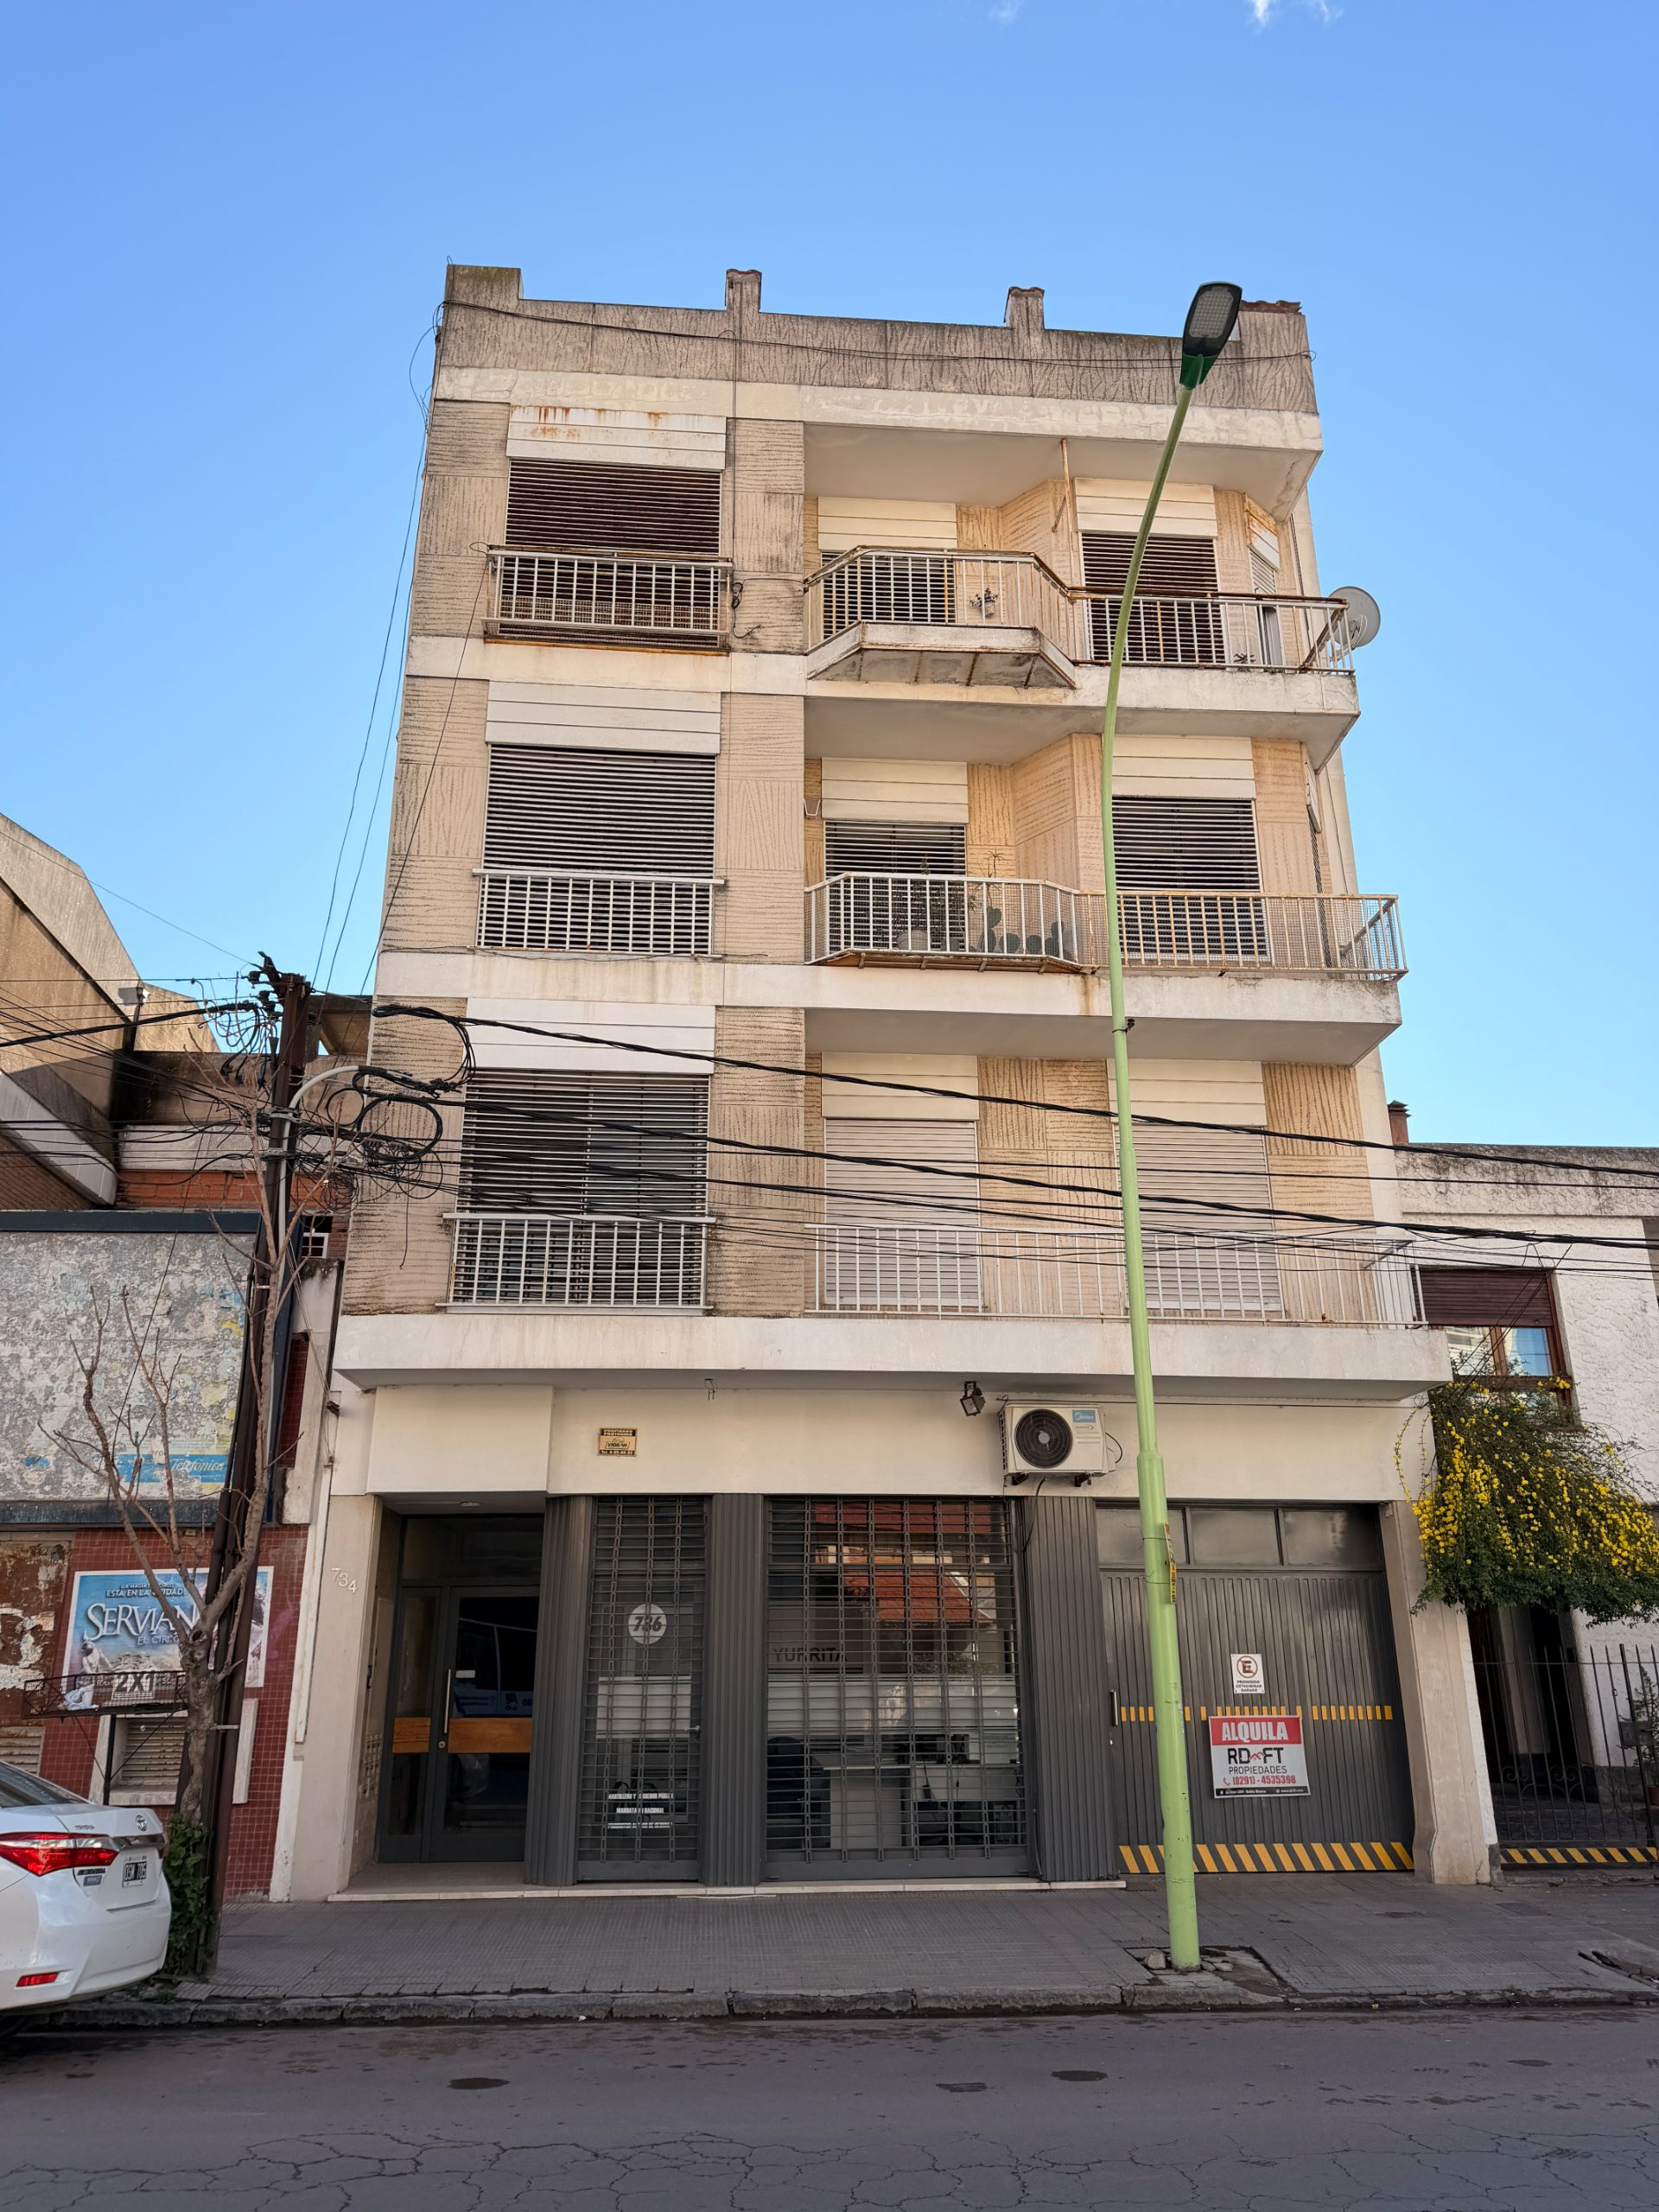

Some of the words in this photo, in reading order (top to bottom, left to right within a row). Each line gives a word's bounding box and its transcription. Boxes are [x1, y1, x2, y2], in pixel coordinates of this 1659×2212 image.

[171, 1458, 225, 1471] Telefónica
[331, 1567, 358, 1593] 734
[106, 1589, 125, 1598] ESTÁ
[1222, 1721, 1289, 1743] ALQUILA
[1229, 1765, 1287, 1775] PROPIEDADES
[1261, 1775, 1297, 1784] 4535398
